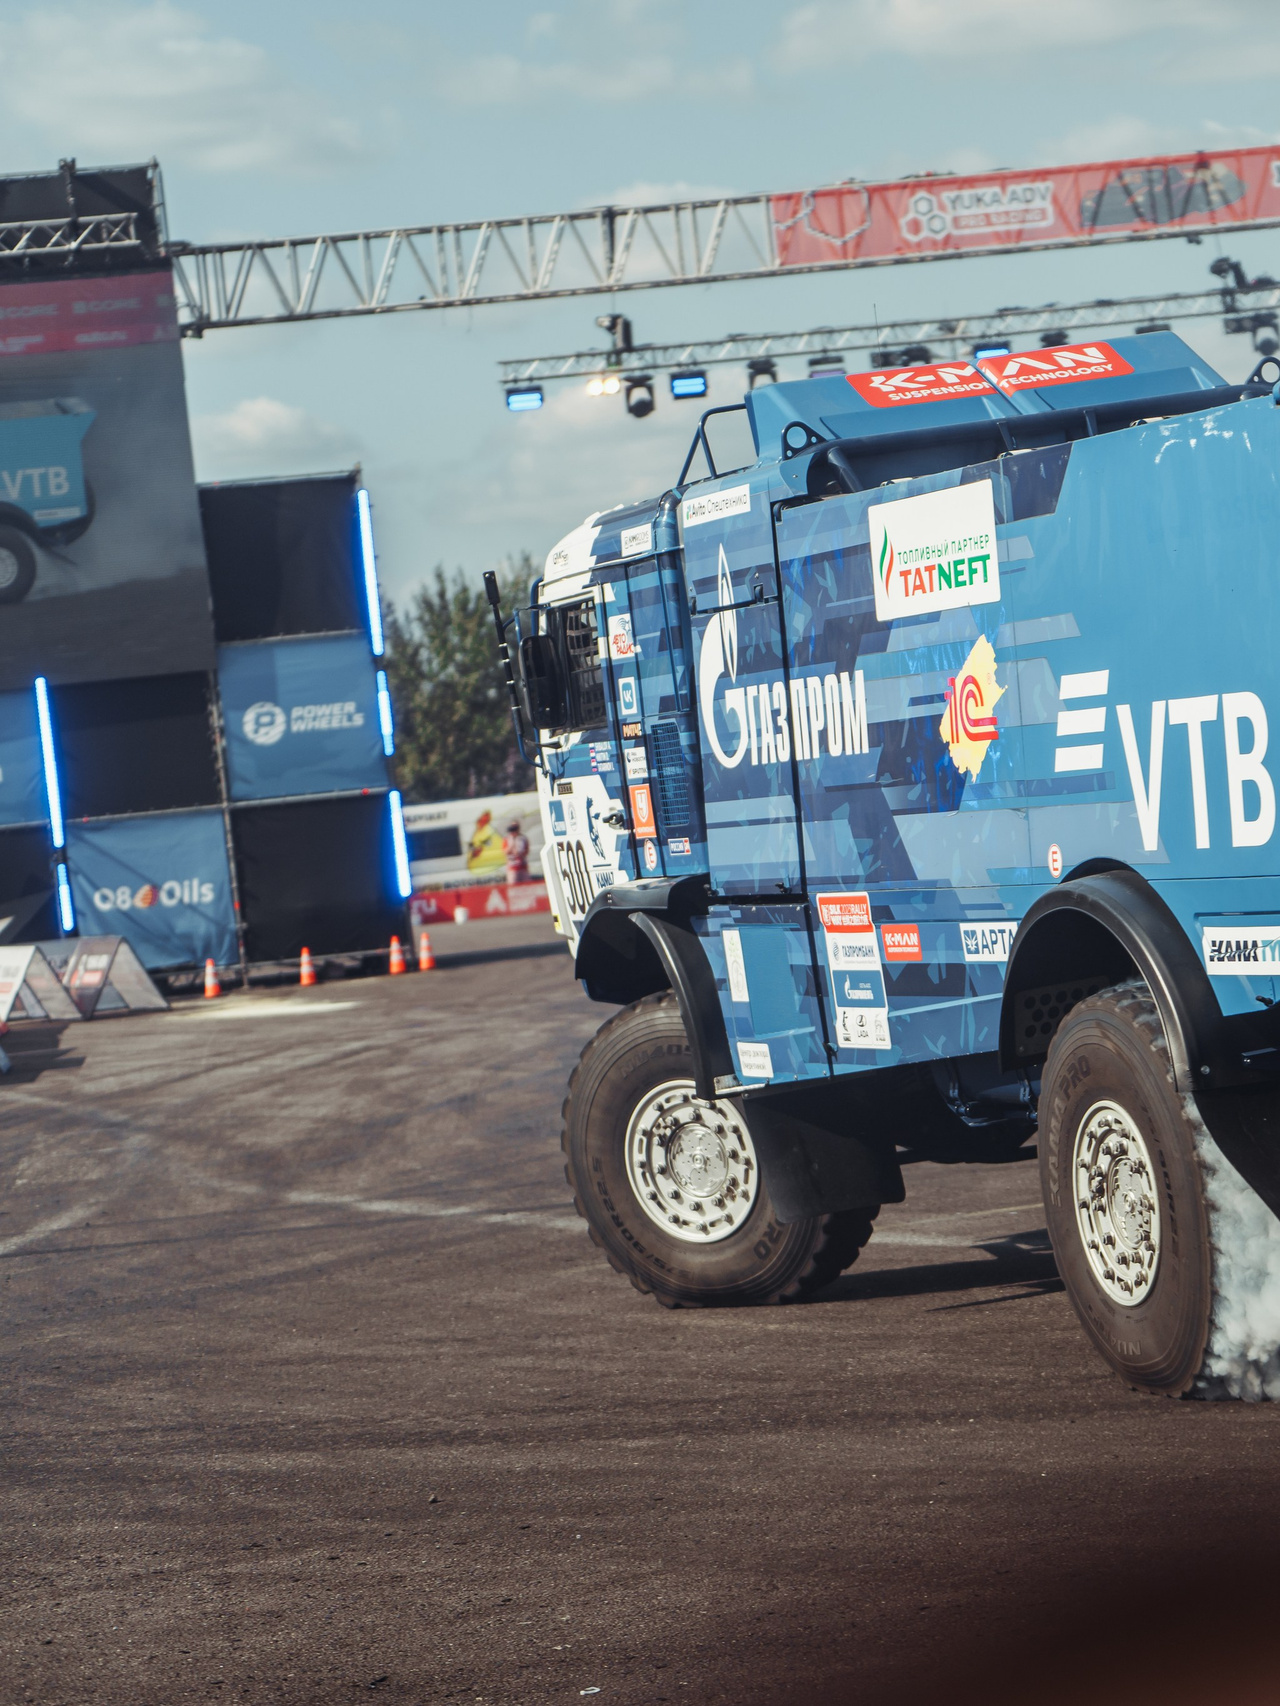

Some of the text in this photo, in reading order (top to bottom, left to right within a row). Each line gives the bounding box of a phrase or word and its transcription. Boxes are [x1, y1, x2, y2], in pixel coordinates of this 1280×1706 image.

[945, 186, 1050, 210] YUKA ADV
[869, 346, 1109, 393] K-MAN
[888, 362, 1115, 401] SUSPENSION TECHNOLOGY
[1, 466, 71, 501] VTB
[897, 534, 990, 565] ТОПЛИВНЫЙ ПАРТНЕР
[899, 553, 991, 598] TATNEFT
[290, 701, 357, 719] POWER
[291, 712, 365, 733] WHEELS
[747, 669, 870, 766] ГАЗПРОМ
[1116, 691, 1276, 852] VTB
[159, 877, 215, 908] Oils
[556, 839, 596, 915] 500
[1058, 1054, 1091, 1100] PRO
